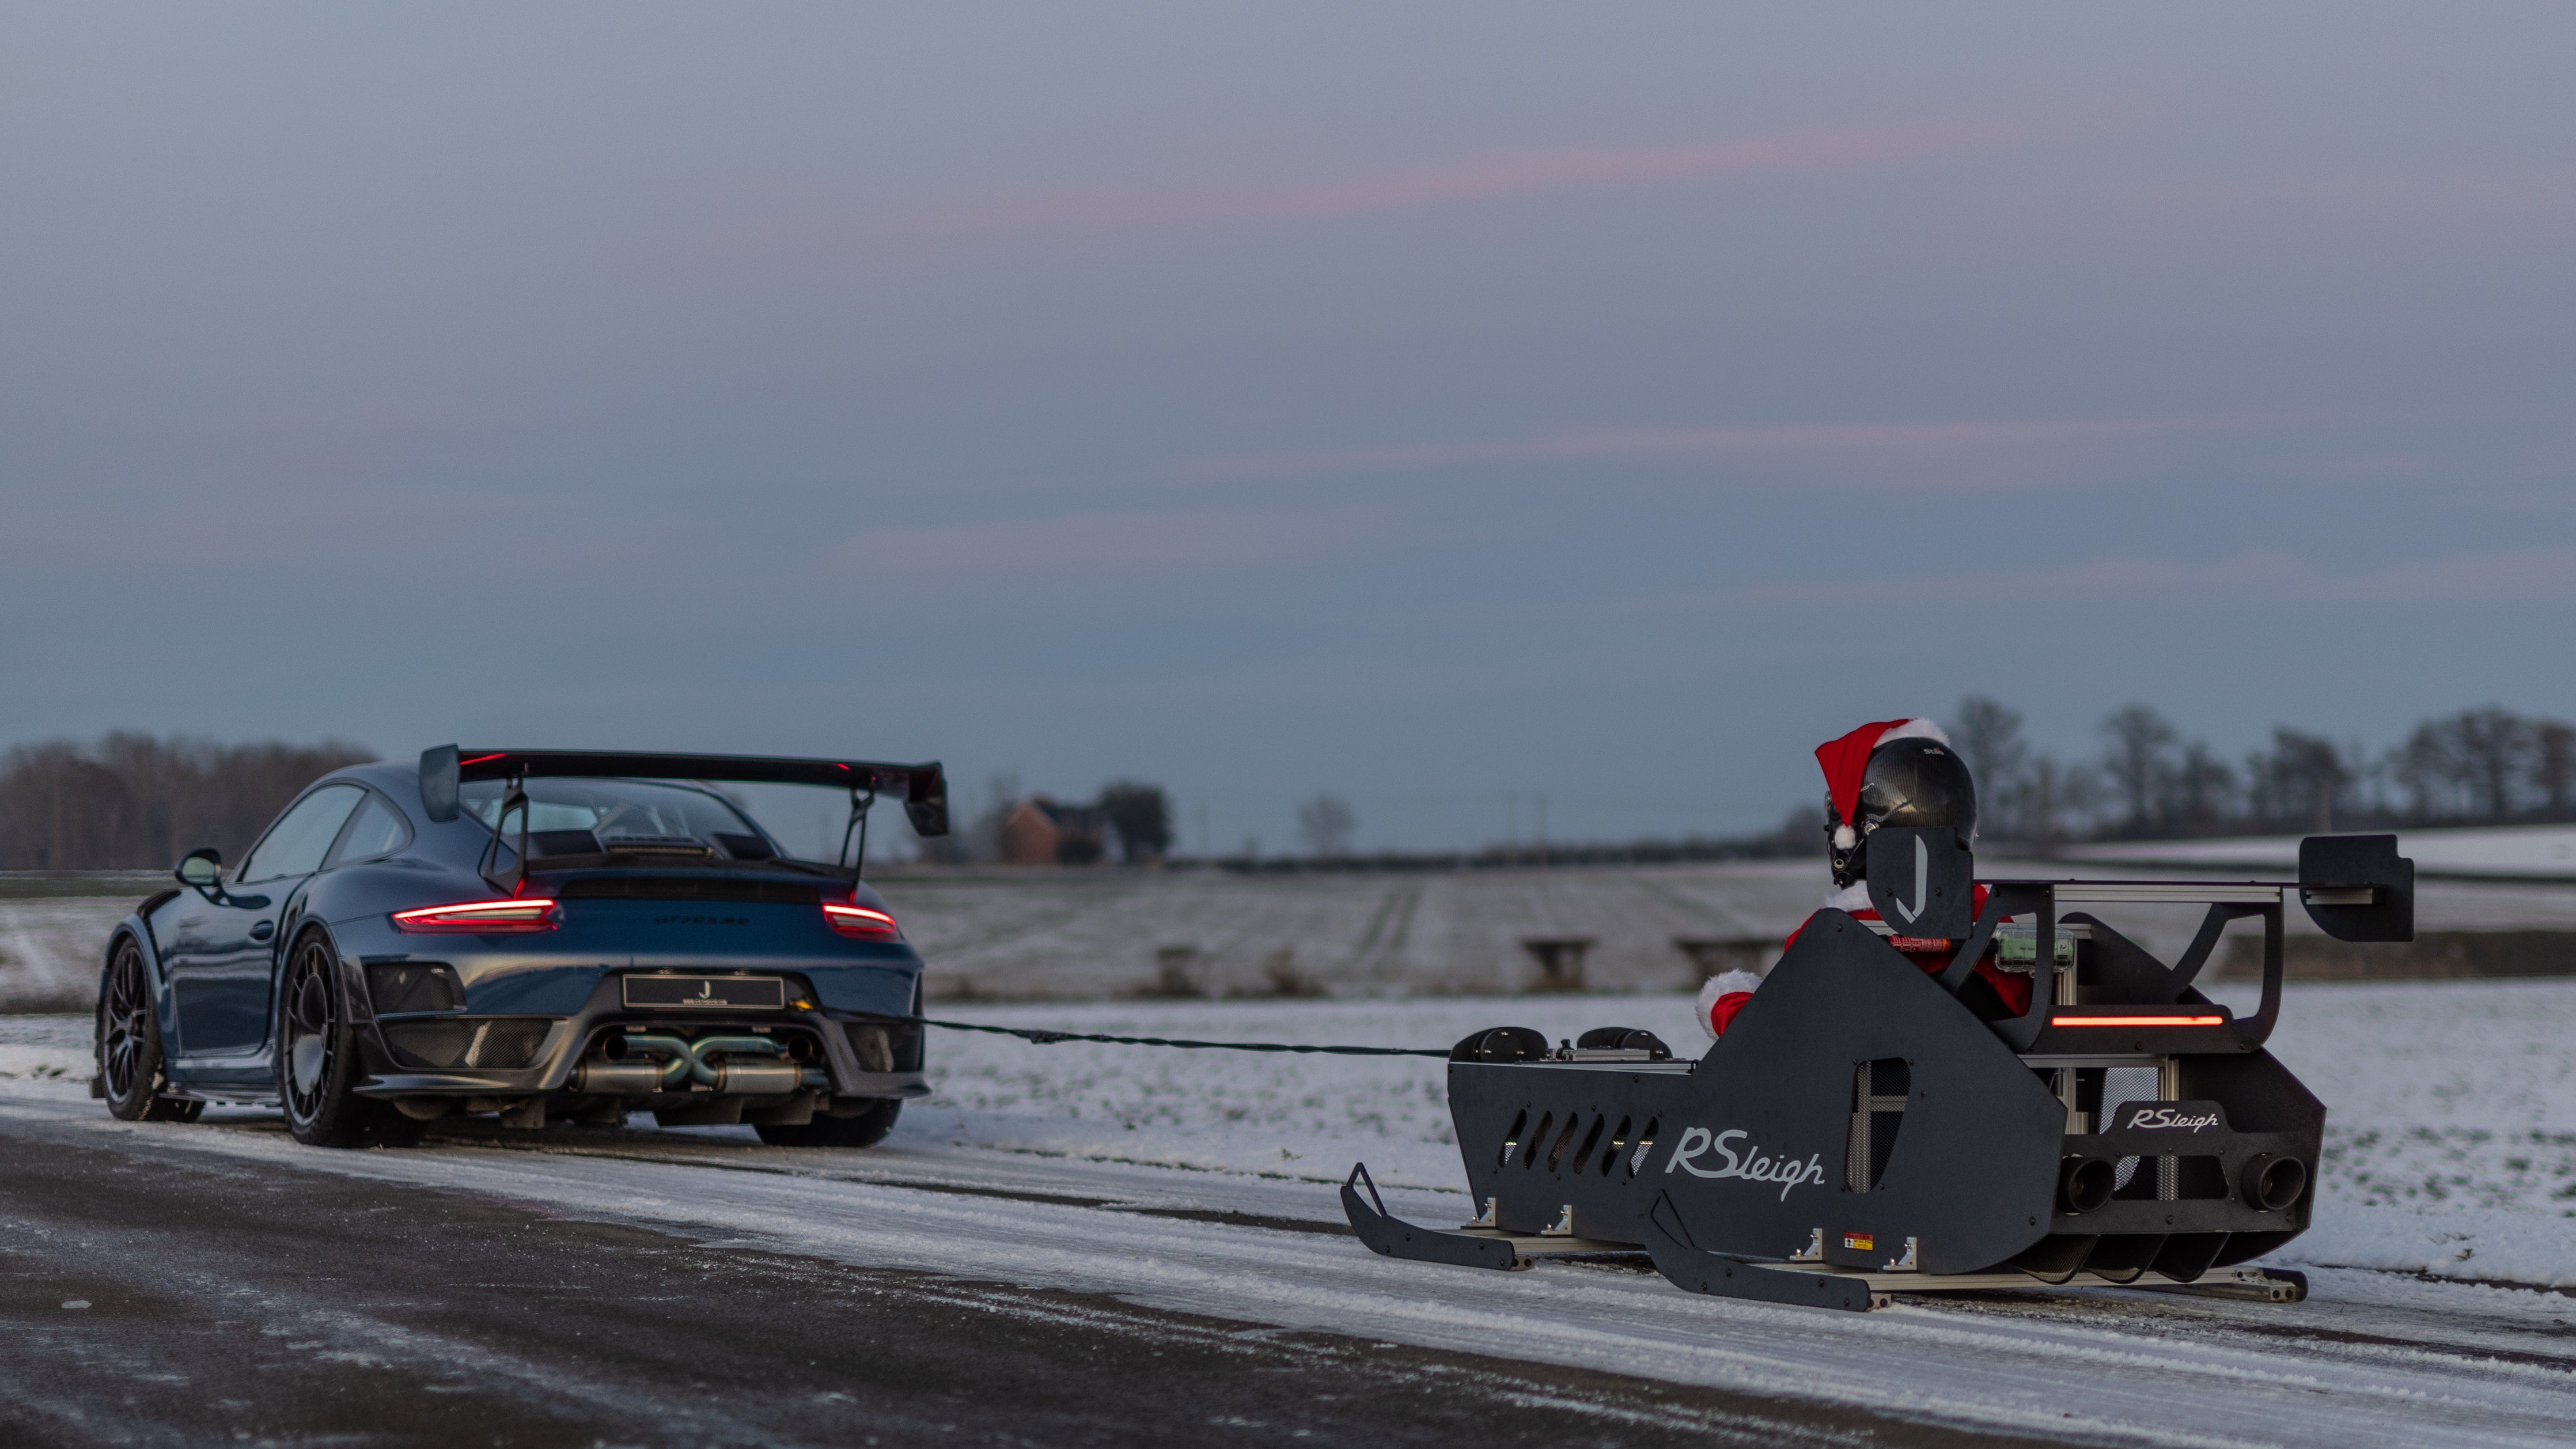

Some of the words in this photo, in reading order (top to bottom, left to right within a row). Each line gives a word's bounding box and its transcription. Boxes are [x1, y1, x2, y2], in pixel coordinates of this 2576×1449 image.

[1896, 834, 1928, 924] J
[2127, 1109, 2218, 1133] RSleigh
[1665, 1127, 1825, 1202] RSleigh
